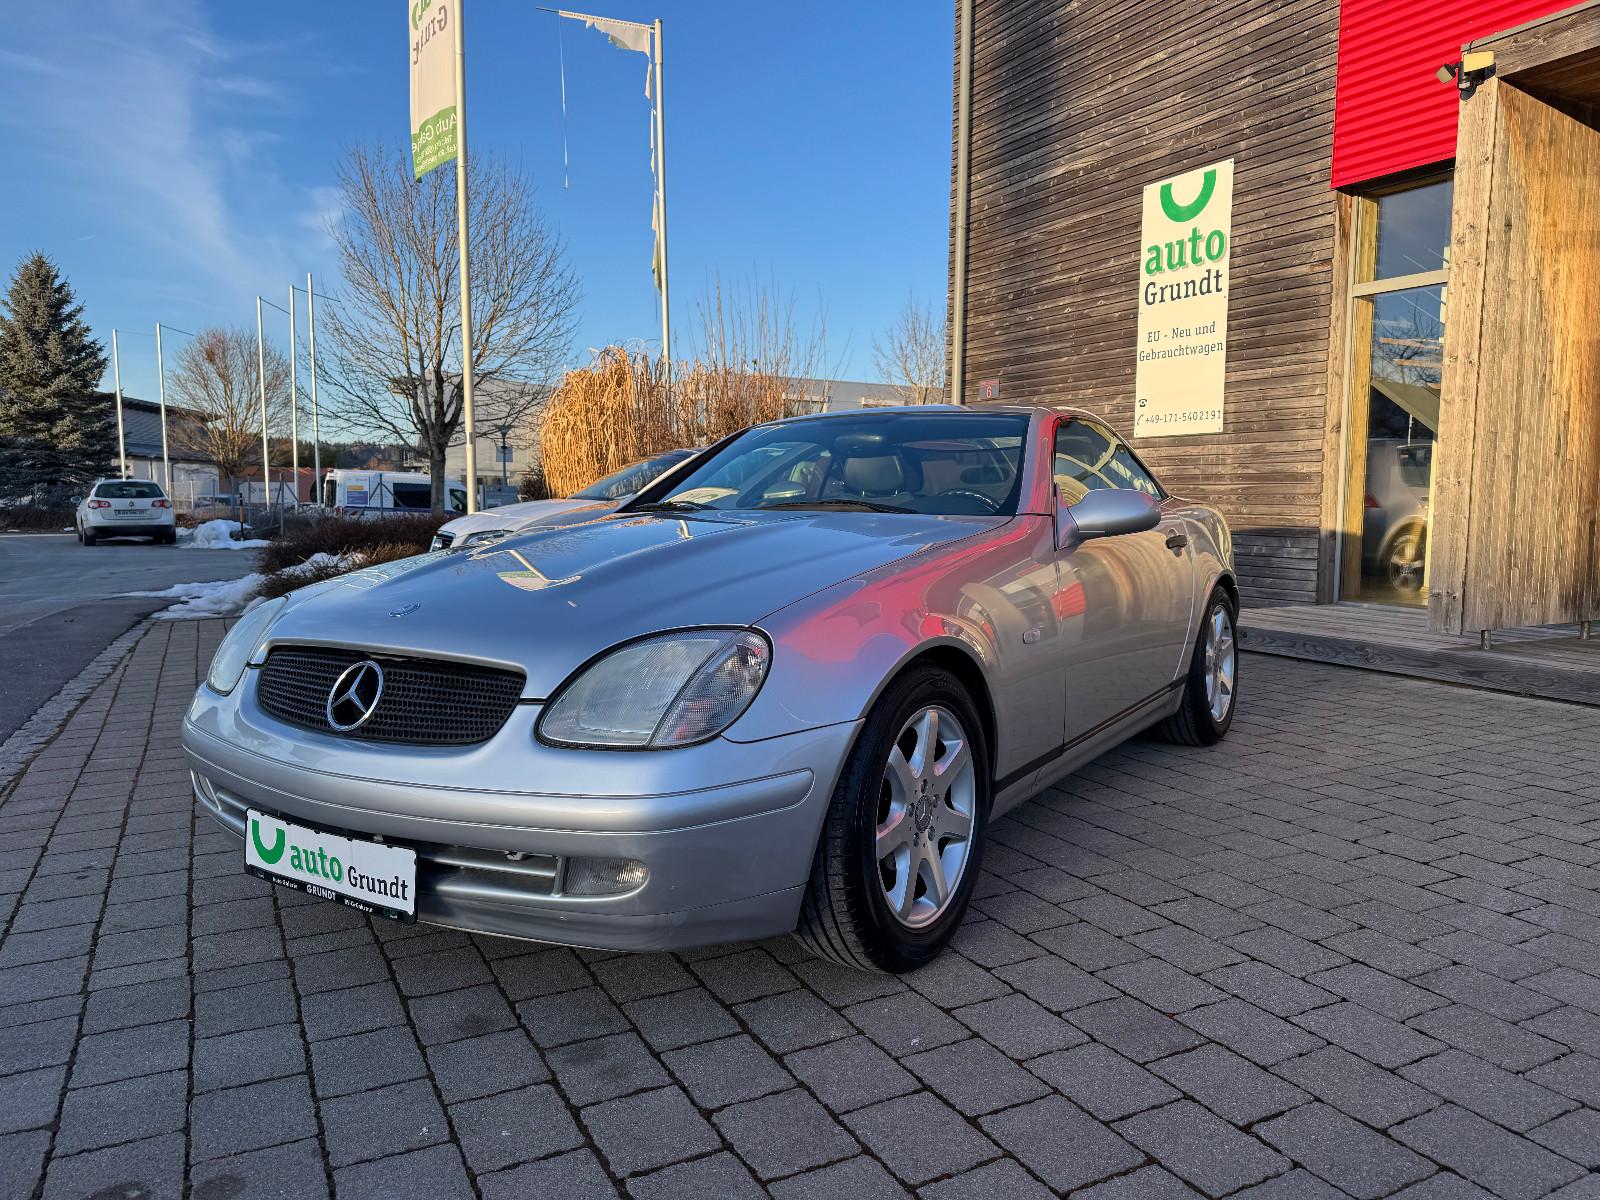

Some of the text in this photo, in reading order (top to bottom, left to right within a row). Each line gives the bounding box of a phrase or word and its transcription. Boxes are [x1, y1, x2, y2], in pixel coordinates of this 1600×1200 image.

[1145, 227, 1226, 275] auto
[1144, 269, 1223, 305] Grundt
[1147, 331, 1160, 342] EU
[1171, 327, 1191, 339] Neu
[1195, 321, 1216, 336] und
[1139, 341, 1223, 361] Gebrauchtwagen
[1145, 410, 1221, 424] +49-171-5402191
[290, 845, 409, 901] auto Grundt
[306, 884, 337, 901] GRUNDT
